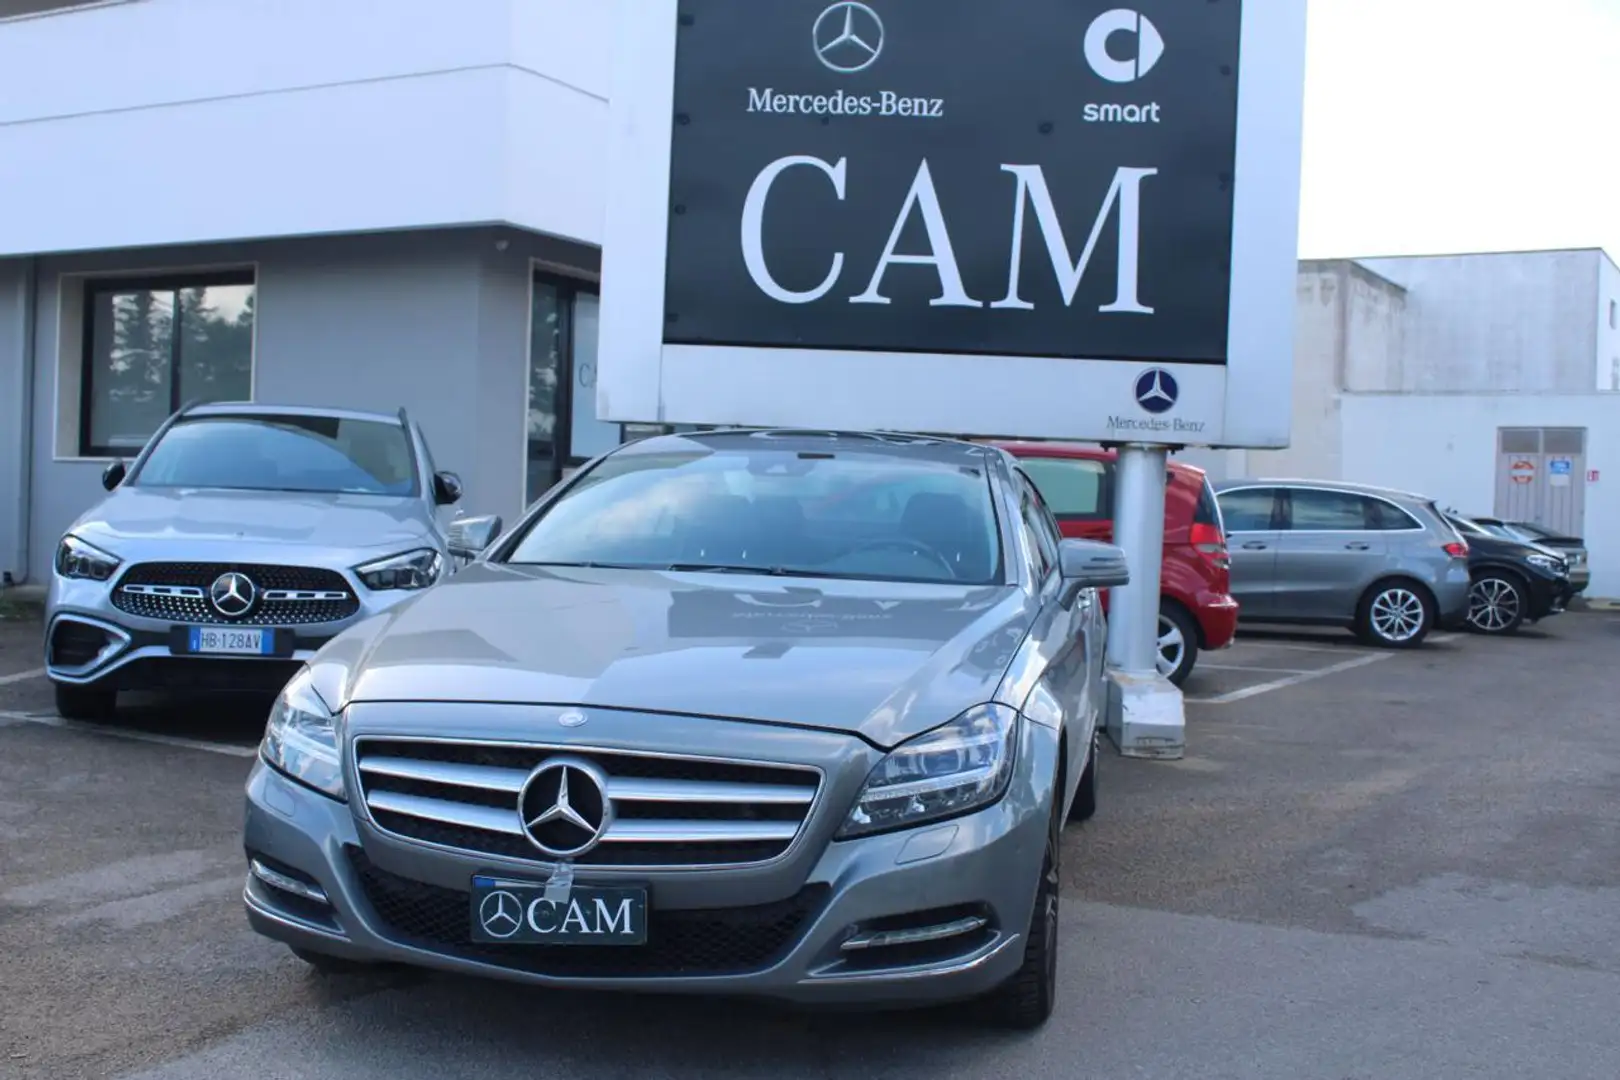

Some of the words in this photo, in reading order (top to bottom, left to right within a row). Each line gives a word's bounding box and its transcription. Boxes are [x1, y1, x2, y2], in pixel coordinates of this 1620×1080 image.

[746, 87, 944, 117] Mercedes-Benz
[1083, 102, 1160, 123] smart
[741, 155, 1158, 314] CAM
[1106, 415, 1206, 432] Mercedes-Benz
[527, 897, 635, 934] CAM
